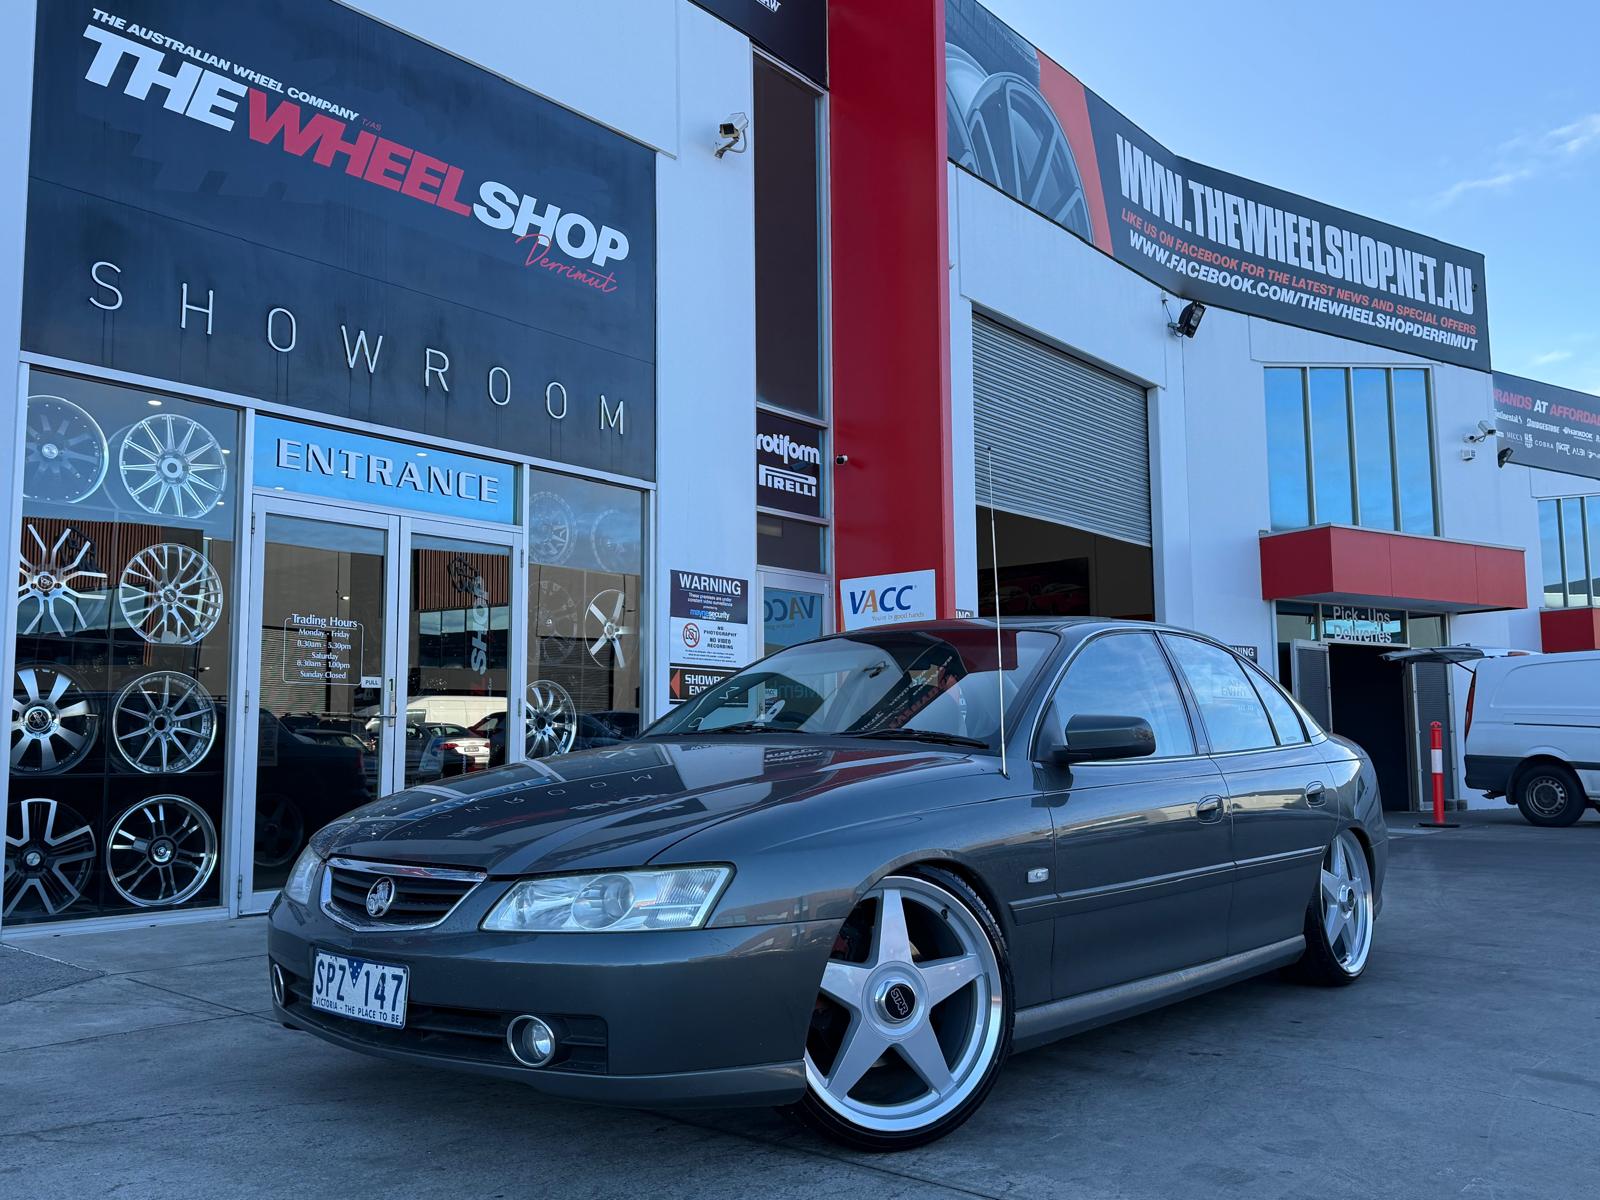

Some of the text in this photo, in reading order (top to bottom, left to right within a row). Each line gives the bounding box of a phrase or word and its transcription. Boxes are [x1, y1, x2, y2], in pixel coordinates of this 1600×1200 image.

[92, 8, 126, 31] THE
[127, 22, 231, 72] AUSTRALIAN
[232, 63, 285, 95] WHEEL
[287, 86, 360, 122] COMPANY
[473, 181, 630, 267] SHOP
[1116, 133, 1474, 315] WWW.THEWHEELSHOP.NET.AU
[514, 233, 618, 293] Derrimut
[1121, 207, 1477, 335] LIKE US ON FACEBOOK FOR THE LATEST NEWS AND SPECIAL OFFERS
[1129, 229, 1479, 352] WWW.FACEBOOK.COM/THEWHEELSHOPDERRIMUT
[1493, 388, 1533, 410] RANDS
[1533, 399, 1549, 414] AT
[756, 433, 820, 464] rotiform
[276, 438, 499, 504] ENTRANCE
[758, 463, 817, 497] PIRELLI
[679, 573, 741, 595] WARNING
[849, 585, 914, 614] VACC
[292, 613, 358, 628] Trading Hours
[1333, 606, 1358, 621] Pick
[1367, 608, 1391, 626] Ups
[298, 628, 325, 638] Monday
[331, 630, 350, 640] Friday
[1334, 624, 1392, 643] Deliveries
[311, 651, 339, 661] Saturday
[300, 670, 347, 679] Sunday Closed
[685, 674, 726, 686] SHOWR
[315, 959, 404, 1012] SPZ 147
[315, 996, 338, 1010] VICTORIA
[344, 1004, 355, 1014] THE
[357, 1007, 376, 1019] PLACE
[379, 1011, 388, 1021] TO
[391, 1013, 400, 1022] BE
